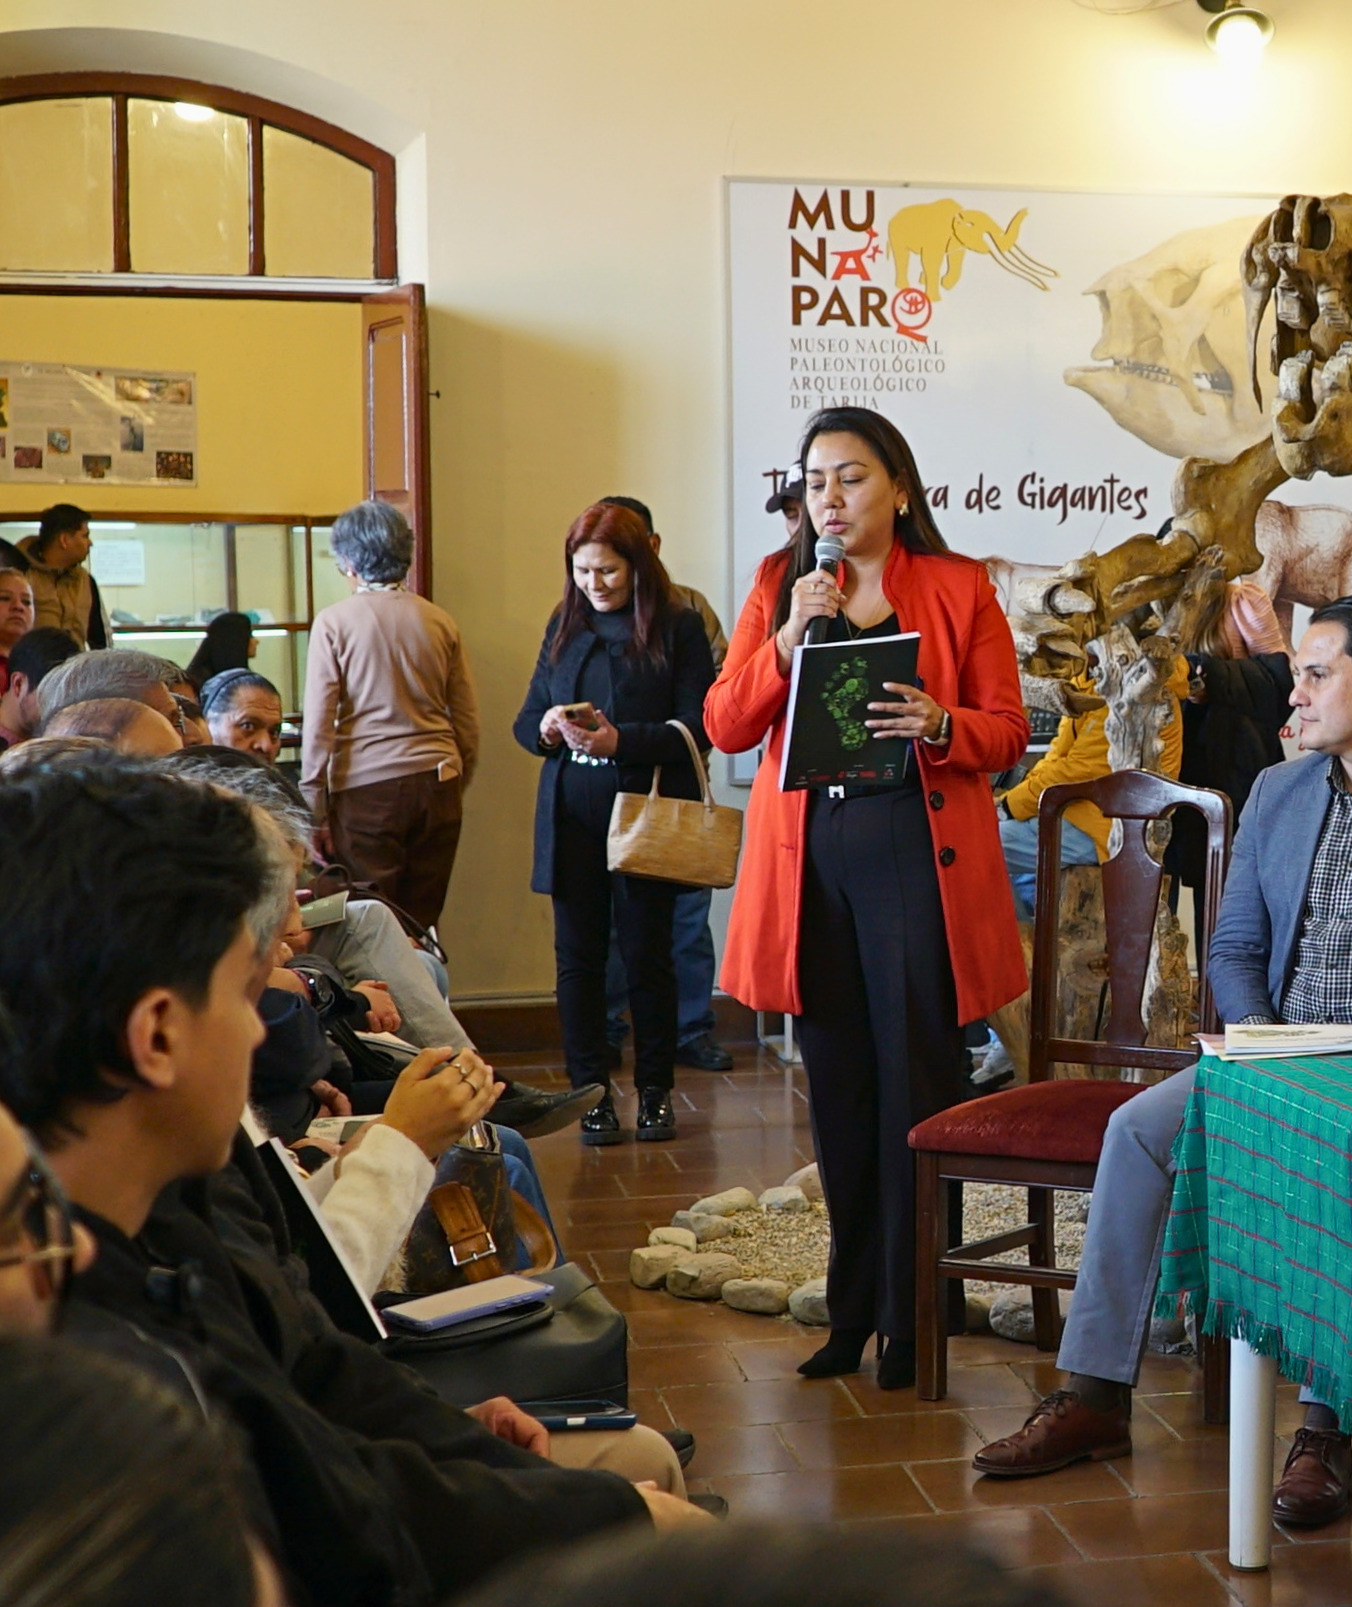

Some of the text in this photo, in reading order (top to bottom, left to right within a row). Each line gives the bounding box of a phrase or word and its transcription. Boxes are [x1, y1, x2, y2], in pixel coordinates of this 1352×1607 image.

[788, 186, 875, 232] MU
[792, 284, 932, 343] PARQ
[790, 338, 943, 355] MUSEO NACIONAL
[790, 355, 945, 373] PALEONTOLÓGICO
[790, 374, 927, 393] ARQUEOLÓGICO
[791, 395, 812, 409] DE
[965, 472, 1001, 514] de
[1017, 472, 1148, 526] Gigantes
